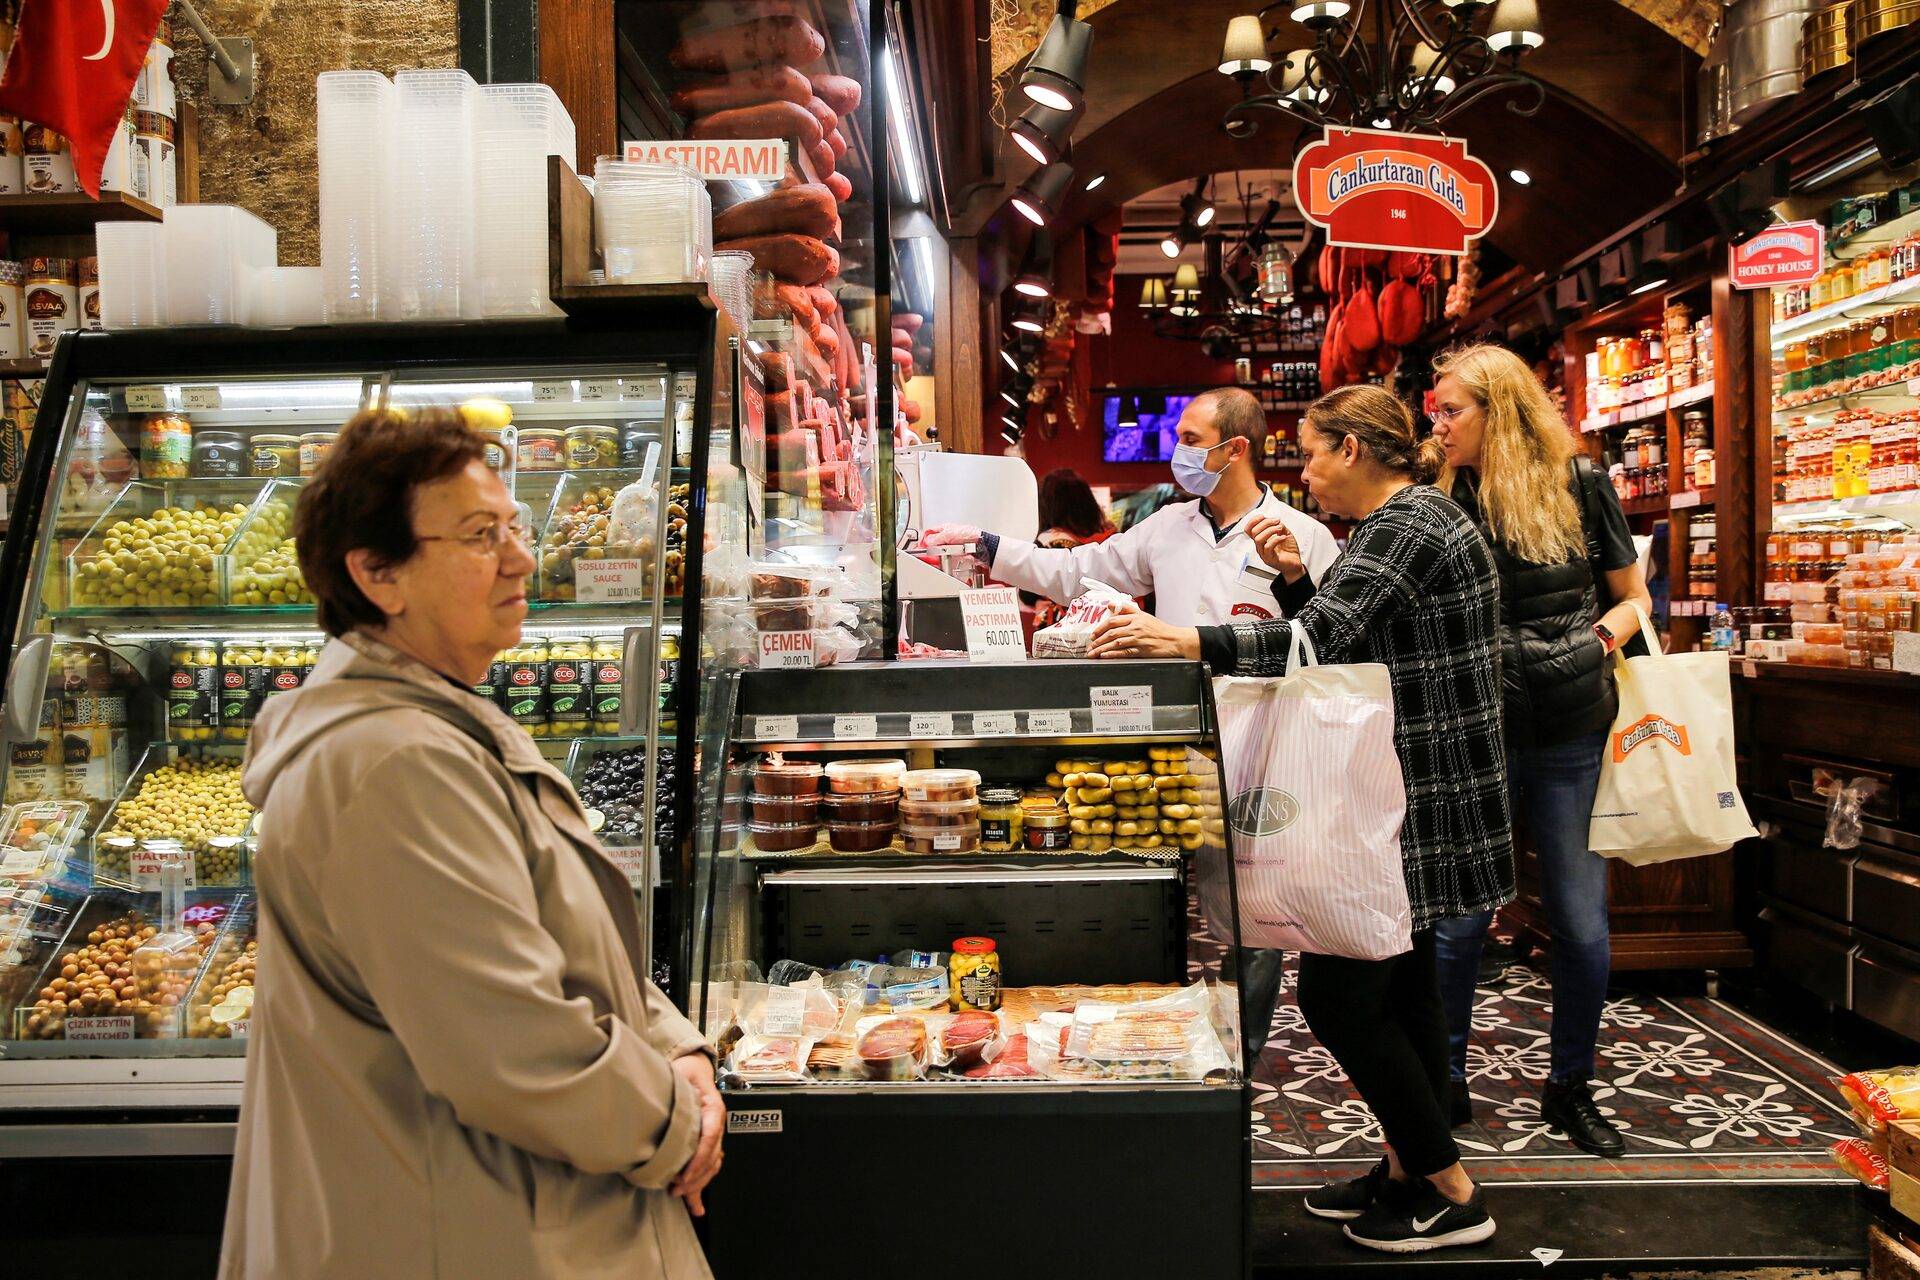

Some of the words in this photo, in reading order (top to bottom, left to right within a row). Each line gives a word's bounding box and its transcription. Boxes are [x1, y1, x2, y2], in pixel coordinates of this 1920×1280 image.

[1328, 156, 1425, 203] Cankurtaran
[1428, 163, 1466, 214] Gıda
[1391, 208, 1407, 219] 1946
[1738, 264, 1775, 277] HONEY
[1777, 260, 1814, 273] HOUSE
[578, 561, 606, 571] SOSLU
[608, 560, 638, 570] ZEYTİN
[593, 574, 622, 583] SAUCE
[964, 590, 1014, 606] YEMEKLİK
[965, 613, 1019, 627] PASTIRMA
[763, 633, 812, 655] ÇEMEN
[986, 630, 1010, 646] 60.00
[1010, 630, 1022, 645] TL
[783, 656, 802, 665] 20.00
[803, 656, 811, 665] TL
[1093, 699, 1129, 707] YUMURTASI
[68, 1019, 93, 1030] ÇİZİK
[97, 1017, 131, 1028] ZEYTİN
[1874, 1088, 1901, 1114] Cipsi
[730, 1112, 780, 1124] beyso
